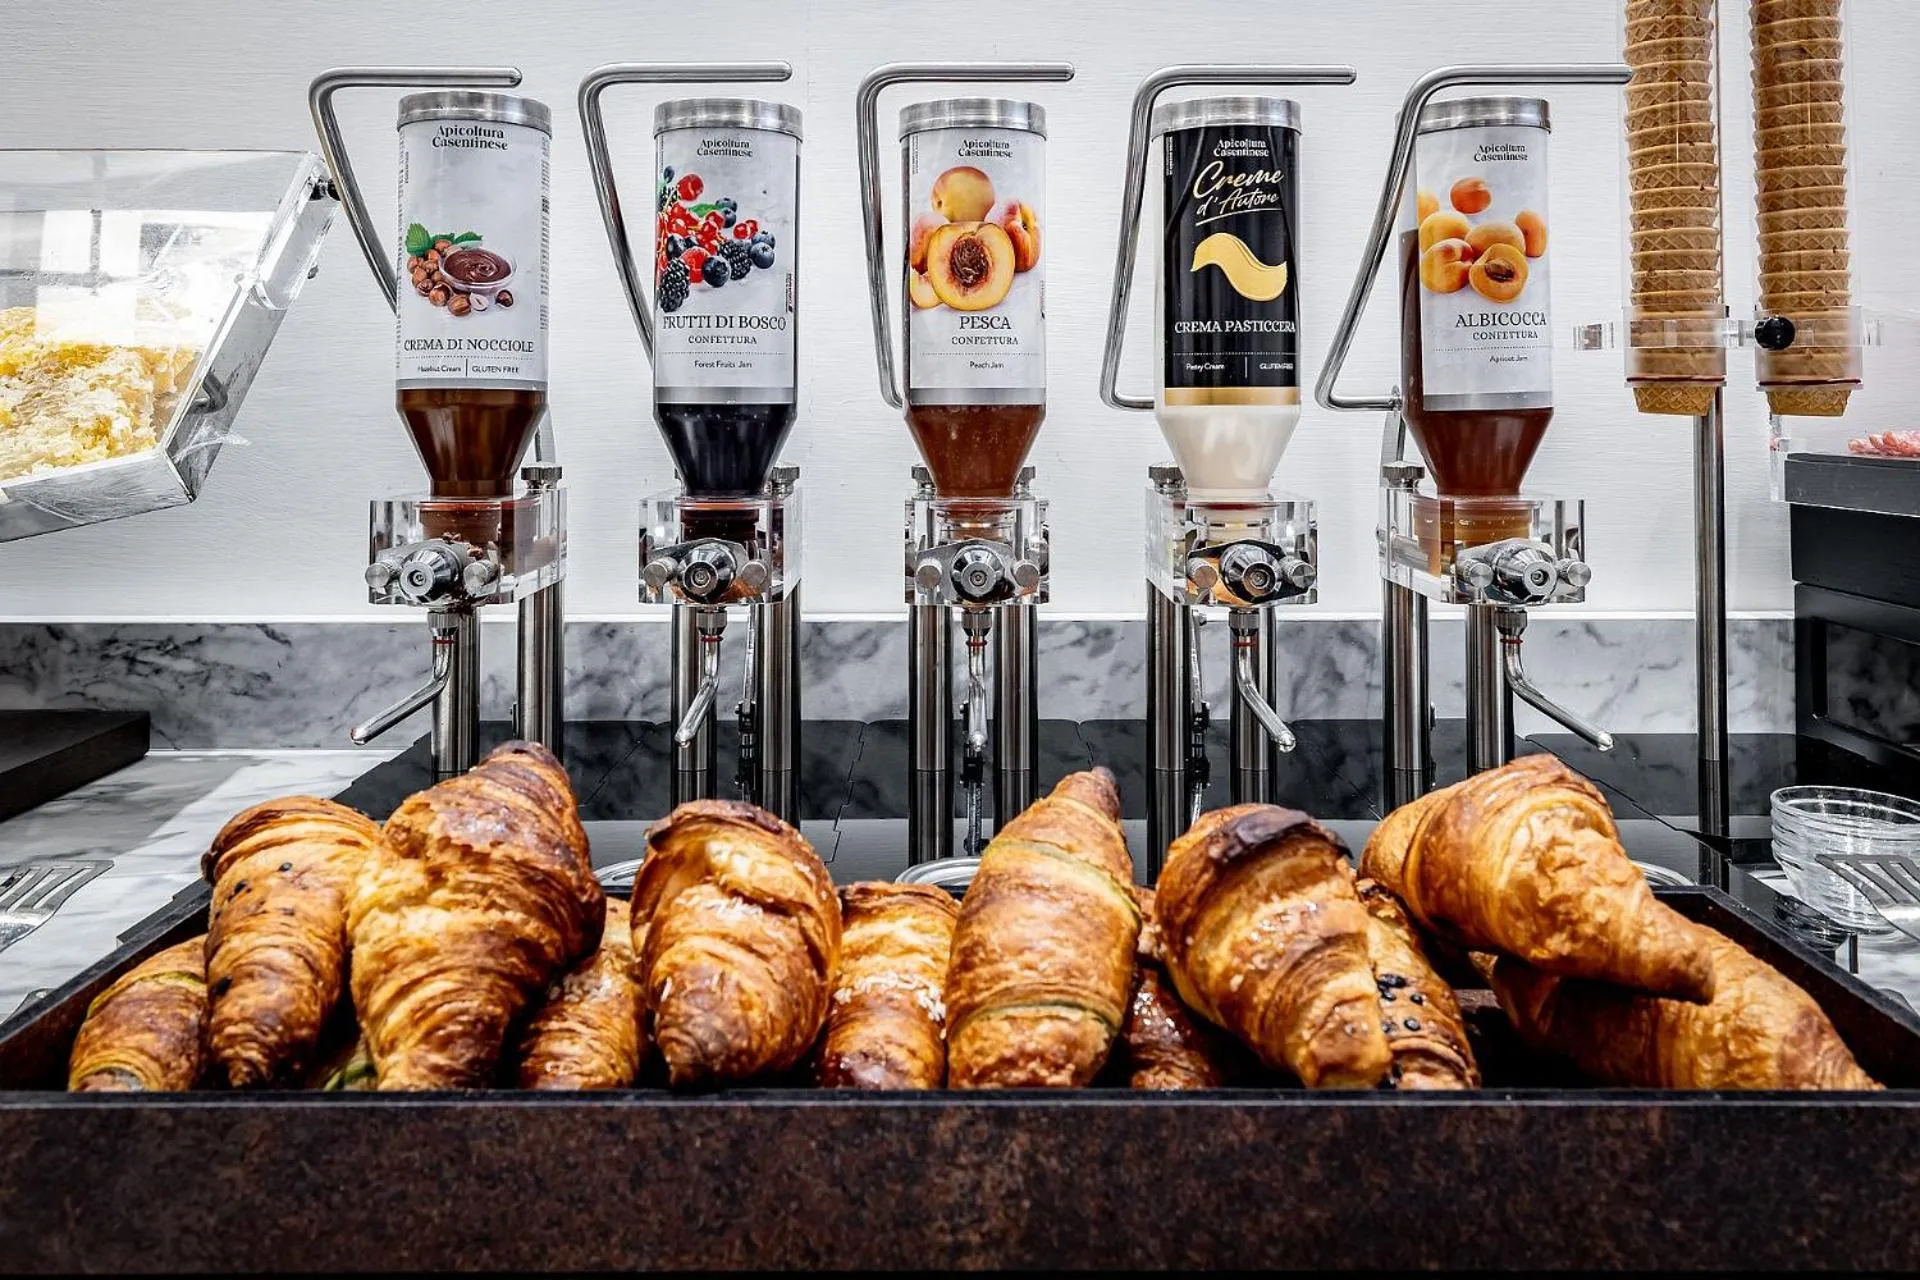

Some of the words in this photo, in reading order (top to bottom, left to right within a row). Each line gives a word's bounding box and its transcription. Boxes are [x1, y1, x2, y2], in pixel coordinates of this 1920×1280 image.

[437, 125, 504, 138] Apicoltura
[432, 136, 508, 150] Casentinese
[701, 138, 750, 149] Apicoltura
[962, 139, 1010, 149] Apicoltura
[1217, 138, 1267, 149] Apicoltura
[697, 148, 753, 157] Casentinese
[958, 148, 1012, 158] Casentinese
[1213, 148, 1269, 157] Casentinese
[1478, 144, 1526, 154] Apicoltura
[1473, 152, 1528, 162] Casentinese
[1193, 160, 1284, 199] Creme
[663, 315, 711, 329] FRUTTI
[715, 315, 734, 329] DI
[739, 315, 786, 330] BOSCO
[959, 315, 1011, 330] PESCA
[1455, 312, 1547, 328] ALBICOCCA
[1174, 320, 1223, 333] CREMA
[1224, 320, 1296, 333] PASTICCERA
[688, 335, 757, 344] CONFETTURA
[951, 336, 1019, 345] CONFETTURA
[1473, 331, 1538, 341] CONFETTURA
[404, 339, 445, 351] CREMA
[447, 339, 463, 351] DI
[467, 339, 534, 352] NOCCIOLE
[694, 360, 715, 368] Forest
[716, 360, 736, 368] Fruits
[1489, 355, 1515, 363] Apricot
[441, 365, 461, 373] Cream
[969, 361, 990, 369] Peach
